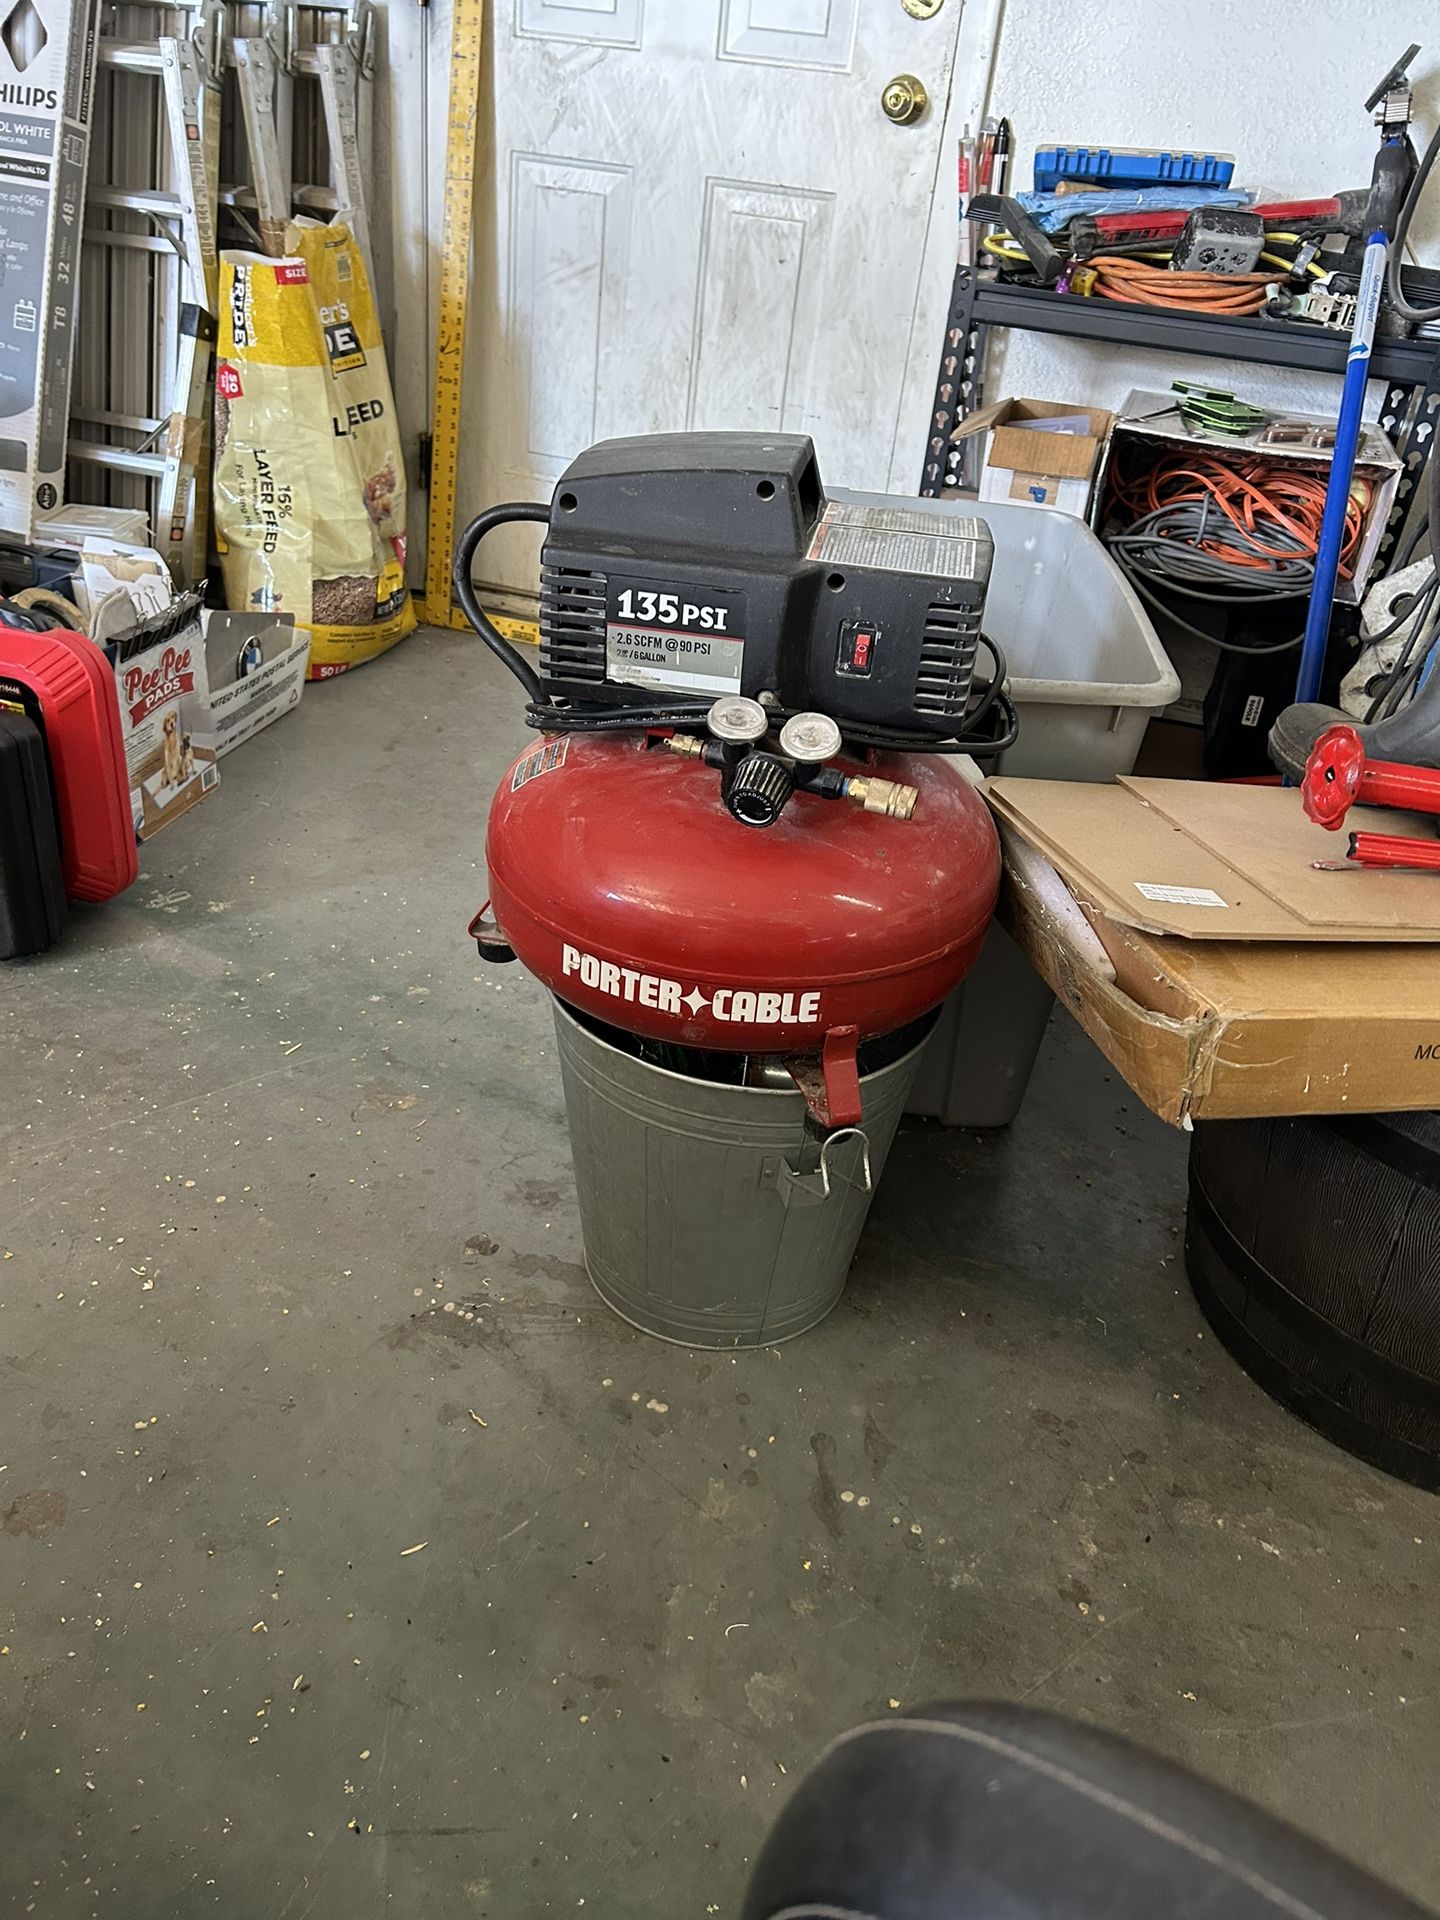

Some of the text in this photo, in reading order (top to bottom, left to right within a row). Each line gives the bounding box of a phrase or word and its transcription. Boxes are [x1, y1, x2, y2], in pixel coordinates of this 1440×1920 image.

[13, 123, 51, 139] WHITE
[62, 203, 75, 226] 48
[57, 262, 71, 285] 32
[285, 268, 307, 279] SIZE
[232, 265, 247, 346] PRIDE
[1367, 274, 1381, 323] Quick-Support
[54, 305, 67, 330] T8
[229, 373, 239, 393] 50
[235, 463, 245, 479] For
[253, 448, 278, 554] LAYER FEED
[278, 484, 293, 519] 16%
[617, 589, 728, 631] 135 PSI
[616, 632, 632, 645] 2.6
[633, 634, 662, 649] SCFM
[694, 642, 711, 655] PSI
[639, 650, 666, 663] GALLON
[124, 647, 192, 702] Pee-Pee
[234, 675, 262, 698] STATES
[261, 659, 286, 681] POSTAL
[320, 666, 334, 677] 50
[145, 677, 181, 708] PADS
[562, 942, 822, 1024] PORTER CABLE
